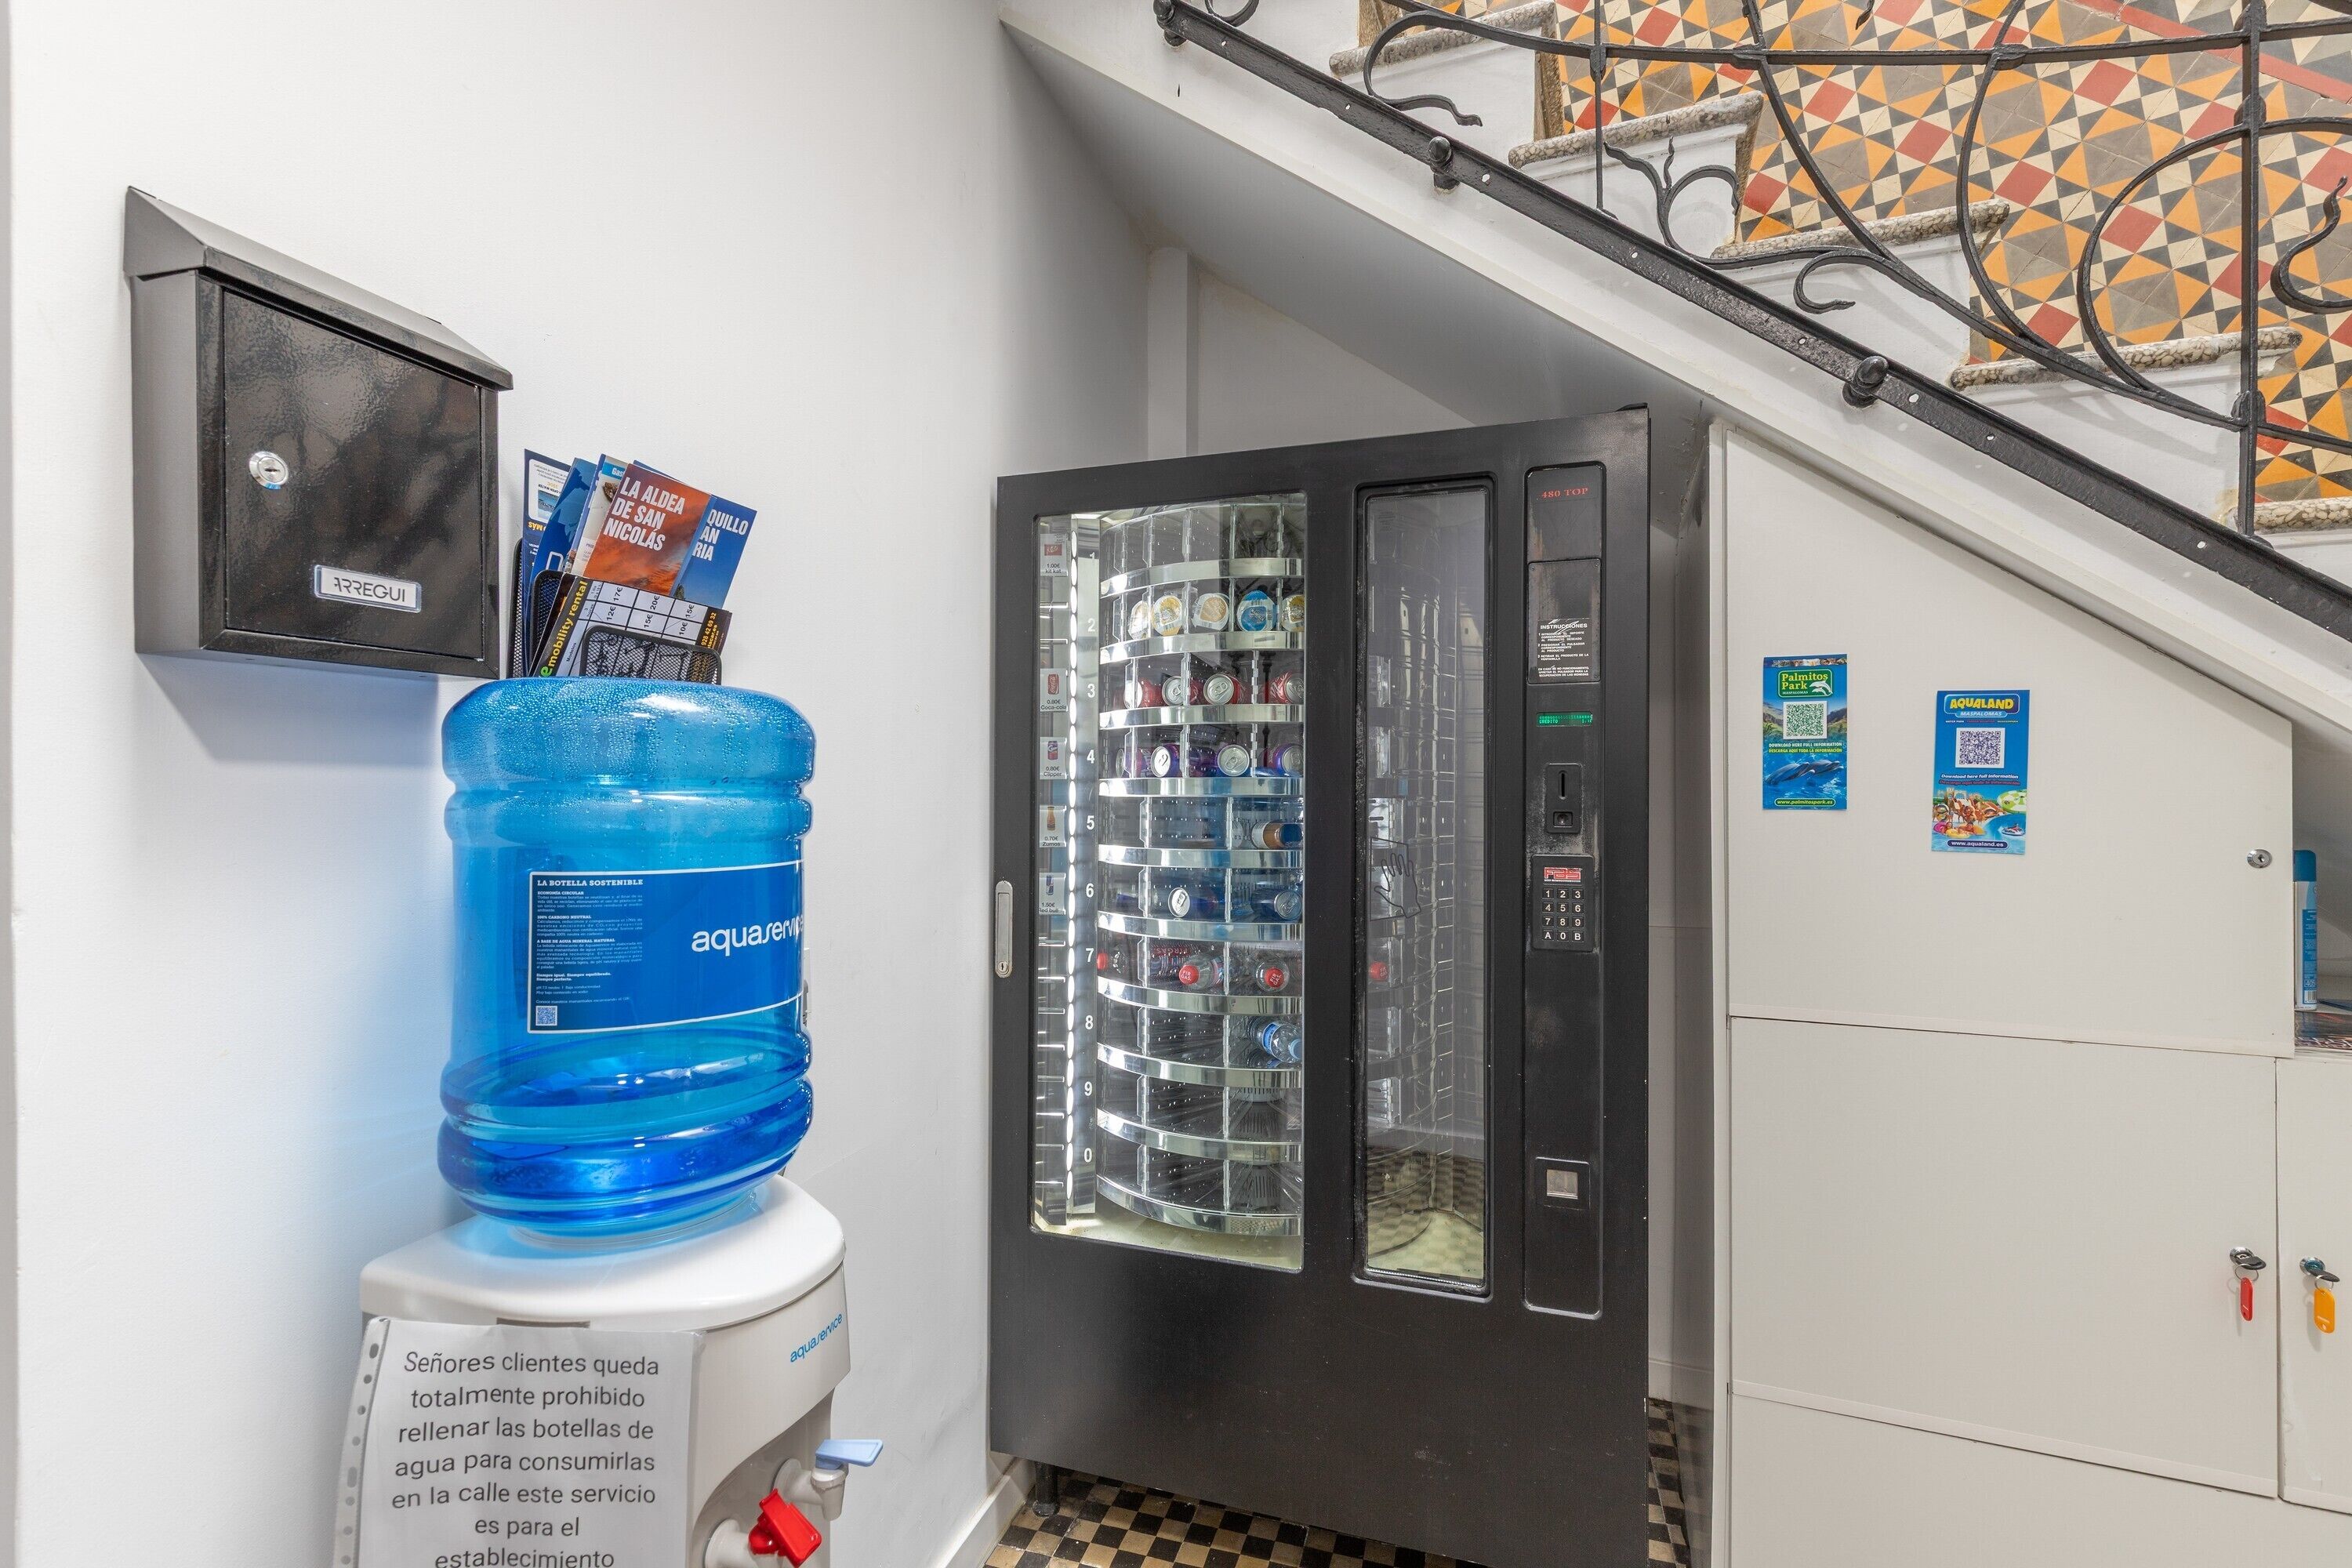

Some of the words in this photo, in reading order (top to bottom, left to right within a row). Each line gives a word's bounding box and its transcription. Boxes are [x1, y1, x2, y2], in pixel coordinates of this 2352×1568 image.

[620, 477, 641, 499] LA
[641, 485, 686, 515] ALDEA
[1542, 490, 1561, 499] 480
[1563, 488, 1588, 496] TOP
[612, 498, 634, 519] DE
[634, 504, 666, 530] SAN
[603, 518, 666, 551] NICOLÁS
[333, 576, 405, 602] ARREGUI
[614, 586, 623, 601] 17€
[568, 581, 588, 616] rental
[650, 595, 660, 611] 20€
[607, 606, 616, 621] 12€
[685, 604, 695, 618] 15€
[644, 614, 653, 629] 15€
[679, 622, 688, 635] 10€
[1087, 618, 1096, 633] 2
[1781, 672, 1828, 681] Palmitos
[1087, 684, 1095, 699] 3
[1782, 681, 1808, 690] Park
[1950, 698, 2014, 710] AQUALAND
[1087, 749, 1095, 764] 4
[1087, 815, 1095, 830] 5
[1086, 883, 1094, 898] 6
[1086, 948, 1094, 963] 7
[1085, 1014, 1094, 1030] 8
[1084, 1081, 1093, 1097] 9
[1083, 1148, 1093, 1163] 0
[790, 1313, 843, 1363] aquaservice
[404, 1351, 495, 1373] Señores
[502, 1352, 587, 1372] clientes
[593, 1356, 659, 1377] queda
[411, 1386, 535, 1408] totalmente
[543, 1386, 645, 1410] prohibido
[398, 1419, 490, 1443] rellenar
[496, 1417, 525, 1438] las
[533, 1418, 621, 1439] botellas
[628, 1421, 654, 1439] de
[394, 1457, 456, 1480] agua
[463, 1454, 511, 1474] para
[518, 1452, 655, 1472] consumirlas
[392, 1491, 421, 1508] en
[430, 1486, 450, 1505] la
[459, 1482, 510, 1503] calle
[517, 1486, 563, 1504] este
[570, 1485, 655, 1504] servicio
[474, 1519, 499, 1534] es
[506, 1519, 553, 1538] para
[561, 1517, 579, 1537] el
[435, 1547, 615, 1568] establecimiento
